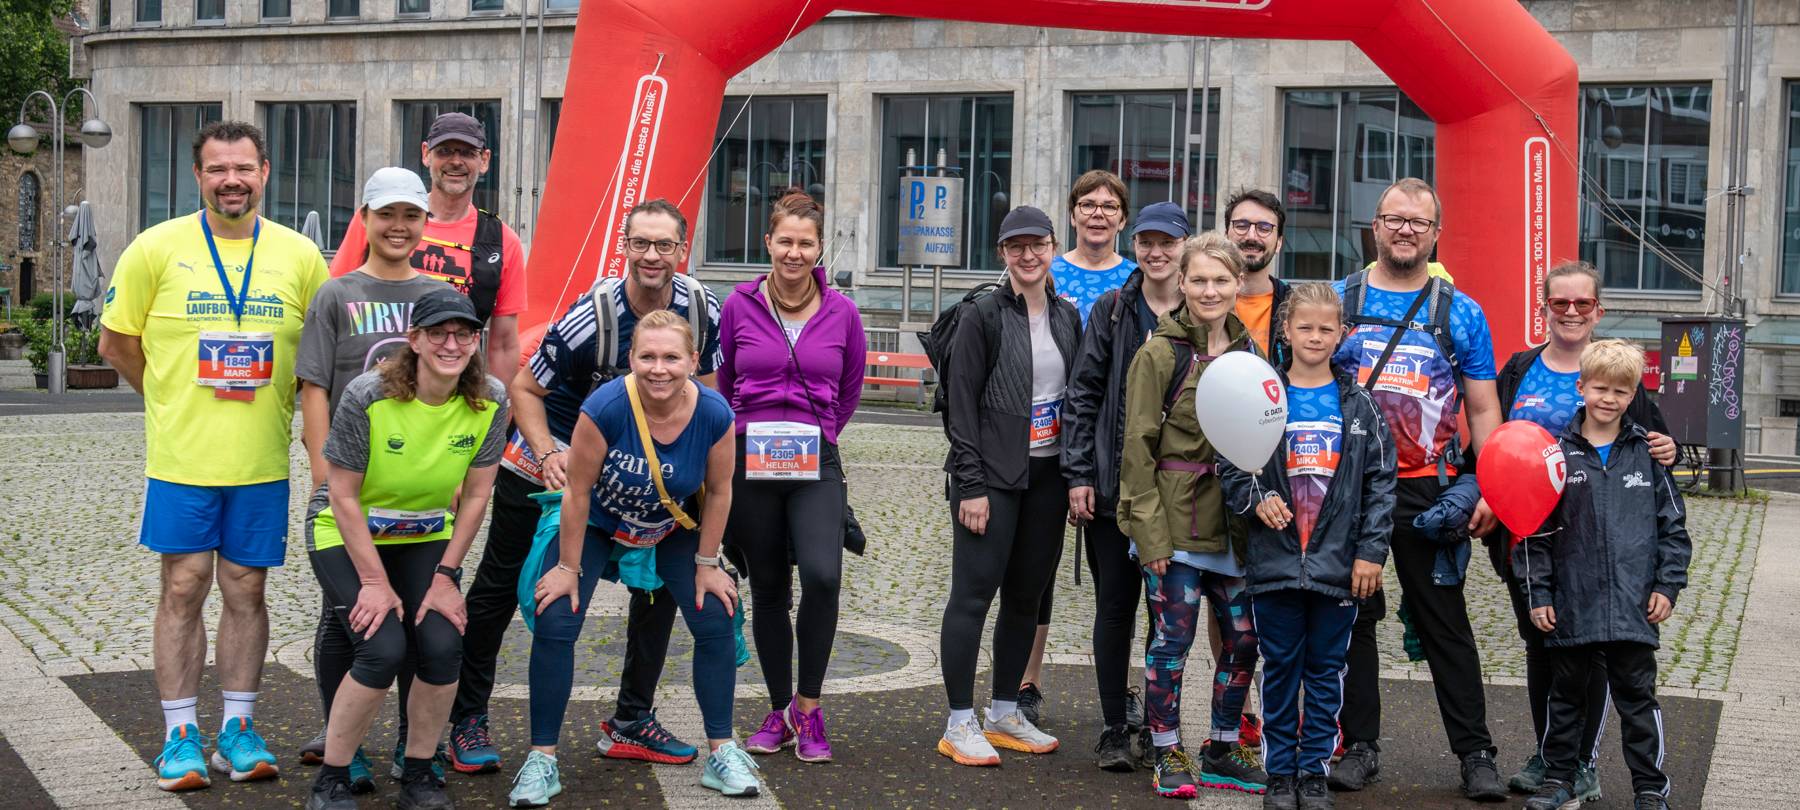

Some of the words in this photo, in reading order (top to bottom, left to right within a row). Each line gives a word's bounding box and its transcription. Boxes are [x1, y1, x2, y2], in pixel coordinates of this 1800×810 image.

[640, 89, 657, 125] Musik.
[634, 125, 650, 157] beste
[631, 158, 642, 176] die
[1534, 149, 1543, 183] Musik.
[623, 176, 639, 209] 100%
[1534, 185, 1543, 213] beste
[1534, 213, 1543, 230] die
[924, 243, 954, 253] AUFZUG
[1534, 231, 1543, 261] 100%
[1534, 262, 1543, 288] hier.
[186, 303, 284, 318] LAUFBOTCHAFTER
[346, 302, 414, 337] NIRV
[225, 356, 251, 367] 1848
[224, 369, 251, 377] MARC
[1385, 365, 1407, 375] 1101
[1379, 376, 1414, 386] AN-PATRIK
[1036, 429, 1053, 438] KIRA
[771, 450, 794, 459] 2305
[1295, 445, 1319, 455] 2403
[1296, 457, 1318, 465] MIKA
